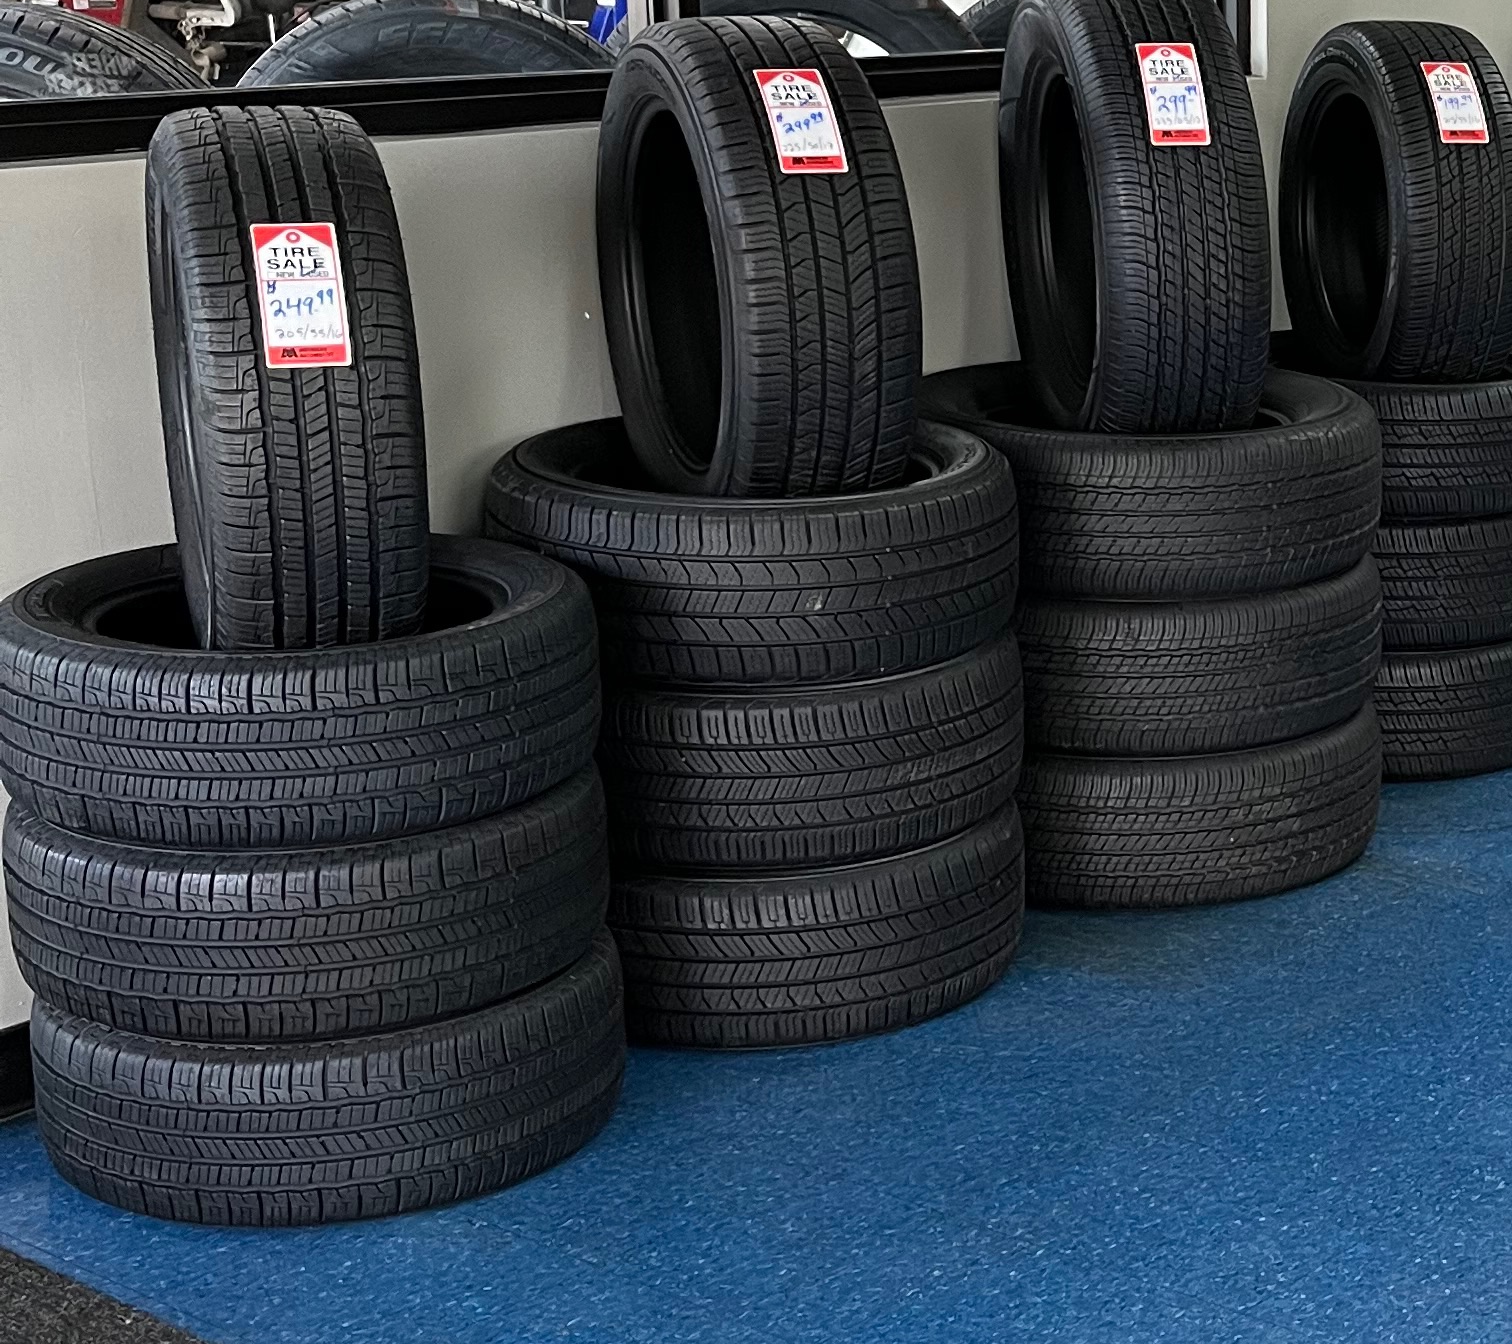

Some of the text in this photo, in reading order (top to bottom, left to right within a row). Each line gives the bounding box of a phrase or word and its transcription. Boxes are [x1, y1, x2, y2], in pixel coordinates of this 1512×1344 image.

[1149, 59, 1186, 68] TIRE
[1148, 67, 1190, 76] SALE
[1432, 73, 1464, 81] TIRE
[770, 84, 813, 93] TIRE
[771, 92, 819, 101] SALE
[269, 246, 321, 258] TIRE
[266, 257, 327, 271] SALE
